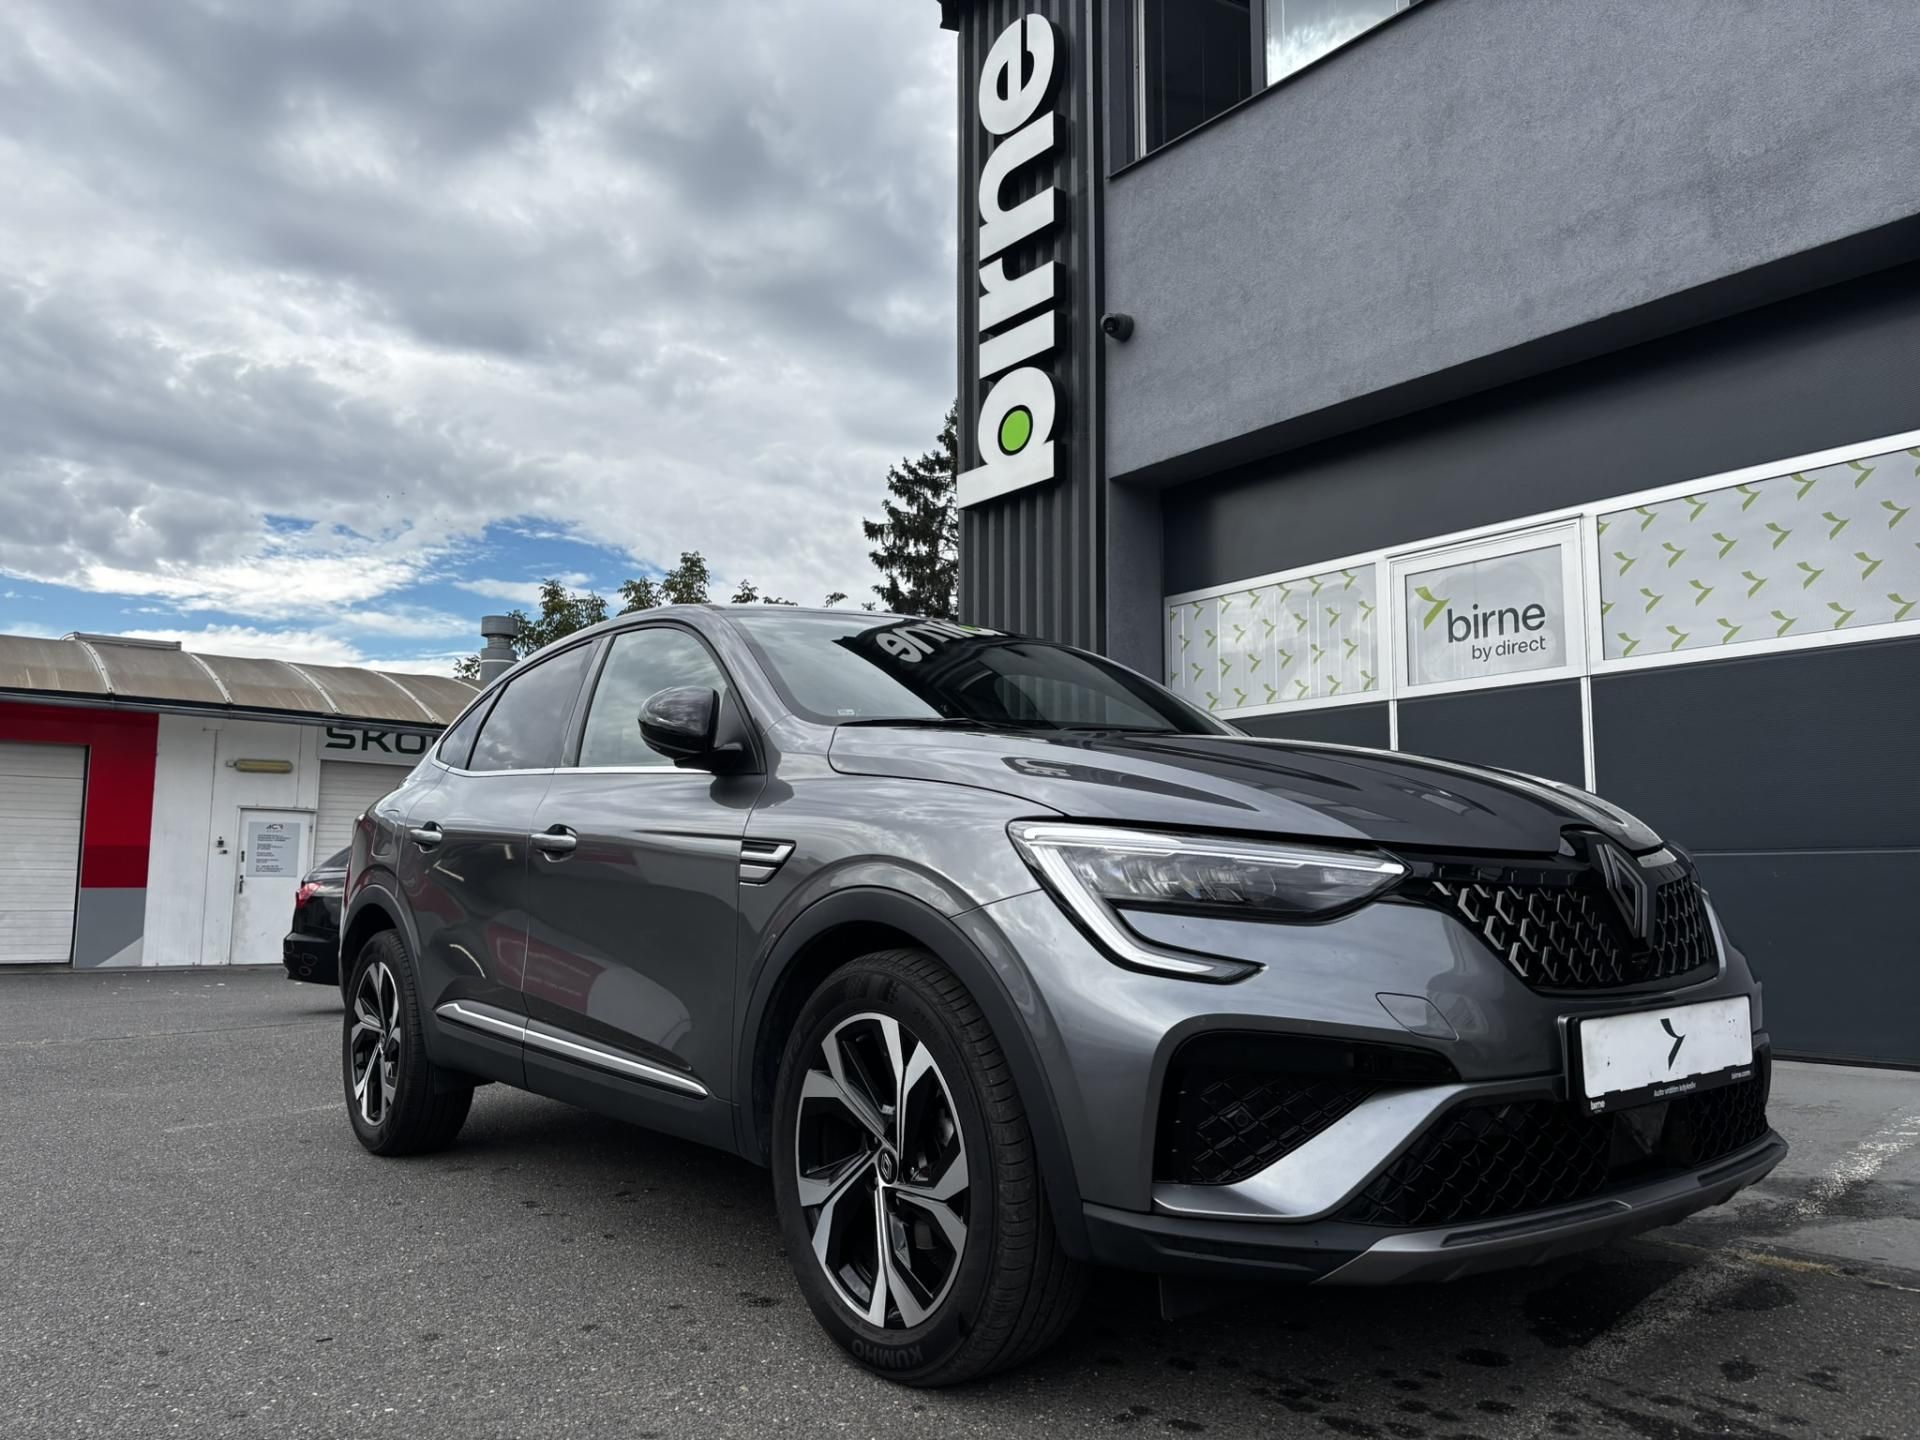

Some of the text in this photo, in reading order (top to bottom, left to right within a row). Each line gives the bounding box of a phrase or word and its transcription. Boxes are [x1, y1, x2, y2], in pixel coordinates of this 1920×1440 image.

[956, 13, 1056, 510] birne
[1447, 603, 1546, 643] birne
[1472, 635, 1546, 662] by direct
[852, 1339, 923, 1369] KUMHO
